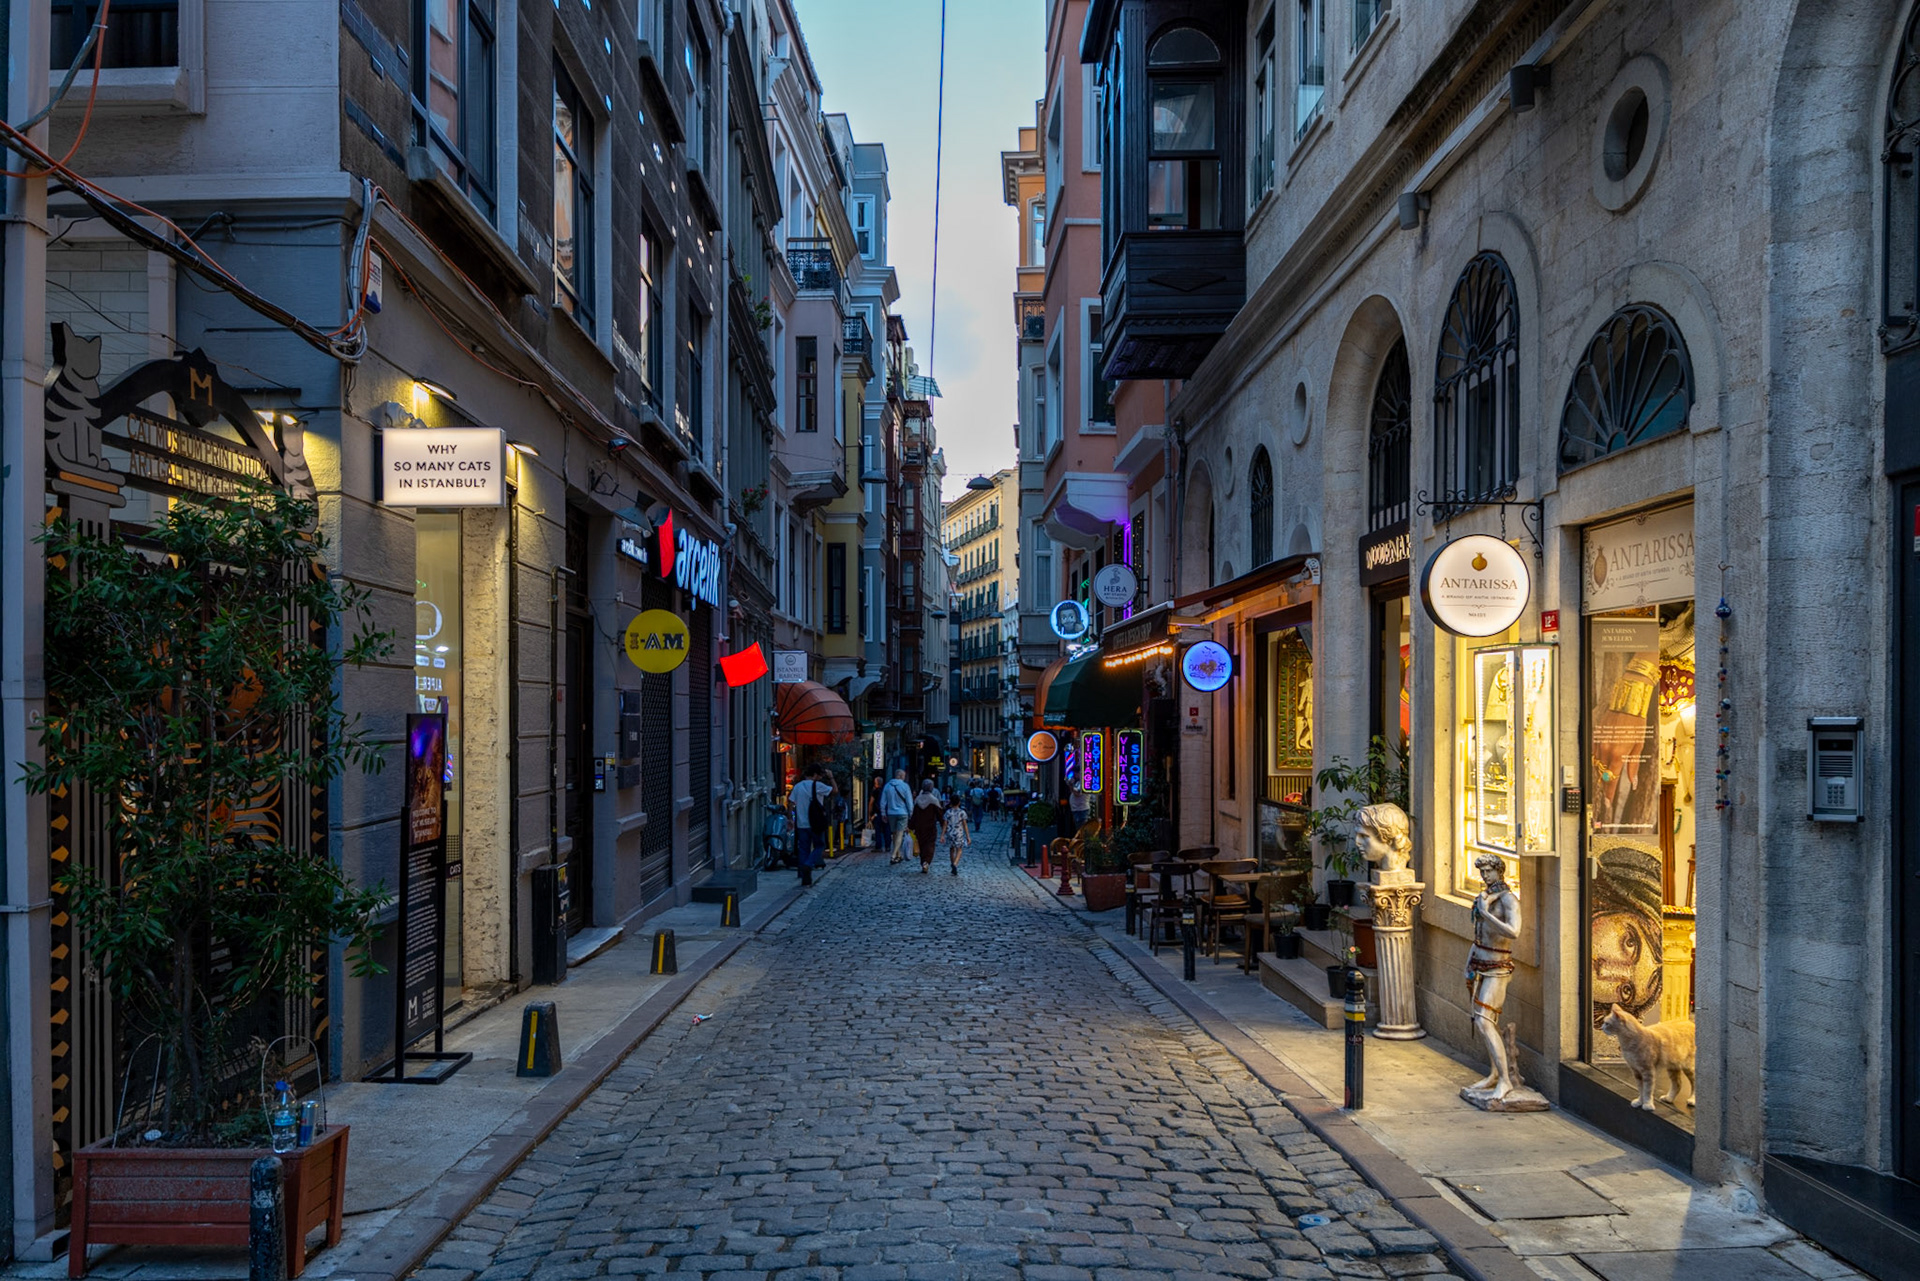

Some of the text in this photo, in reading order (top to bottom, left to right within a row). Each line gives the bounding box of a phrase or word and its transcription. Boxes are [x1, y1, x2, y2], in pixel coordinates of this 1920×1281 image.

[189, 367, 213, 407] M
[127, 412, 272, 481] CAT MUSEUM PRINT STUDIO
[394, 461, 491, 471] SO MANY CATS
[427, 444, 457, 454] WHY
[130, 449, 155, 477] ART
[157, 457, 209, 494] GALLERY
[399, 478, 486, 488] IN ISTANBUL?
[675, 528, 720, 611] arçelik
[1610, 530, 1695, 571] ANTARISSA
[1440, 577, 1518, 590] ANTARISSA
[1084, 736, 1092, 789] VINTAGE
[1092, 734, 1101, 791] CLOTHING
[1119, 736, 1128, 800] VINTAGE
[1130, 744, 1140, 794] STORE
[408, 996, 418, 1020] M
